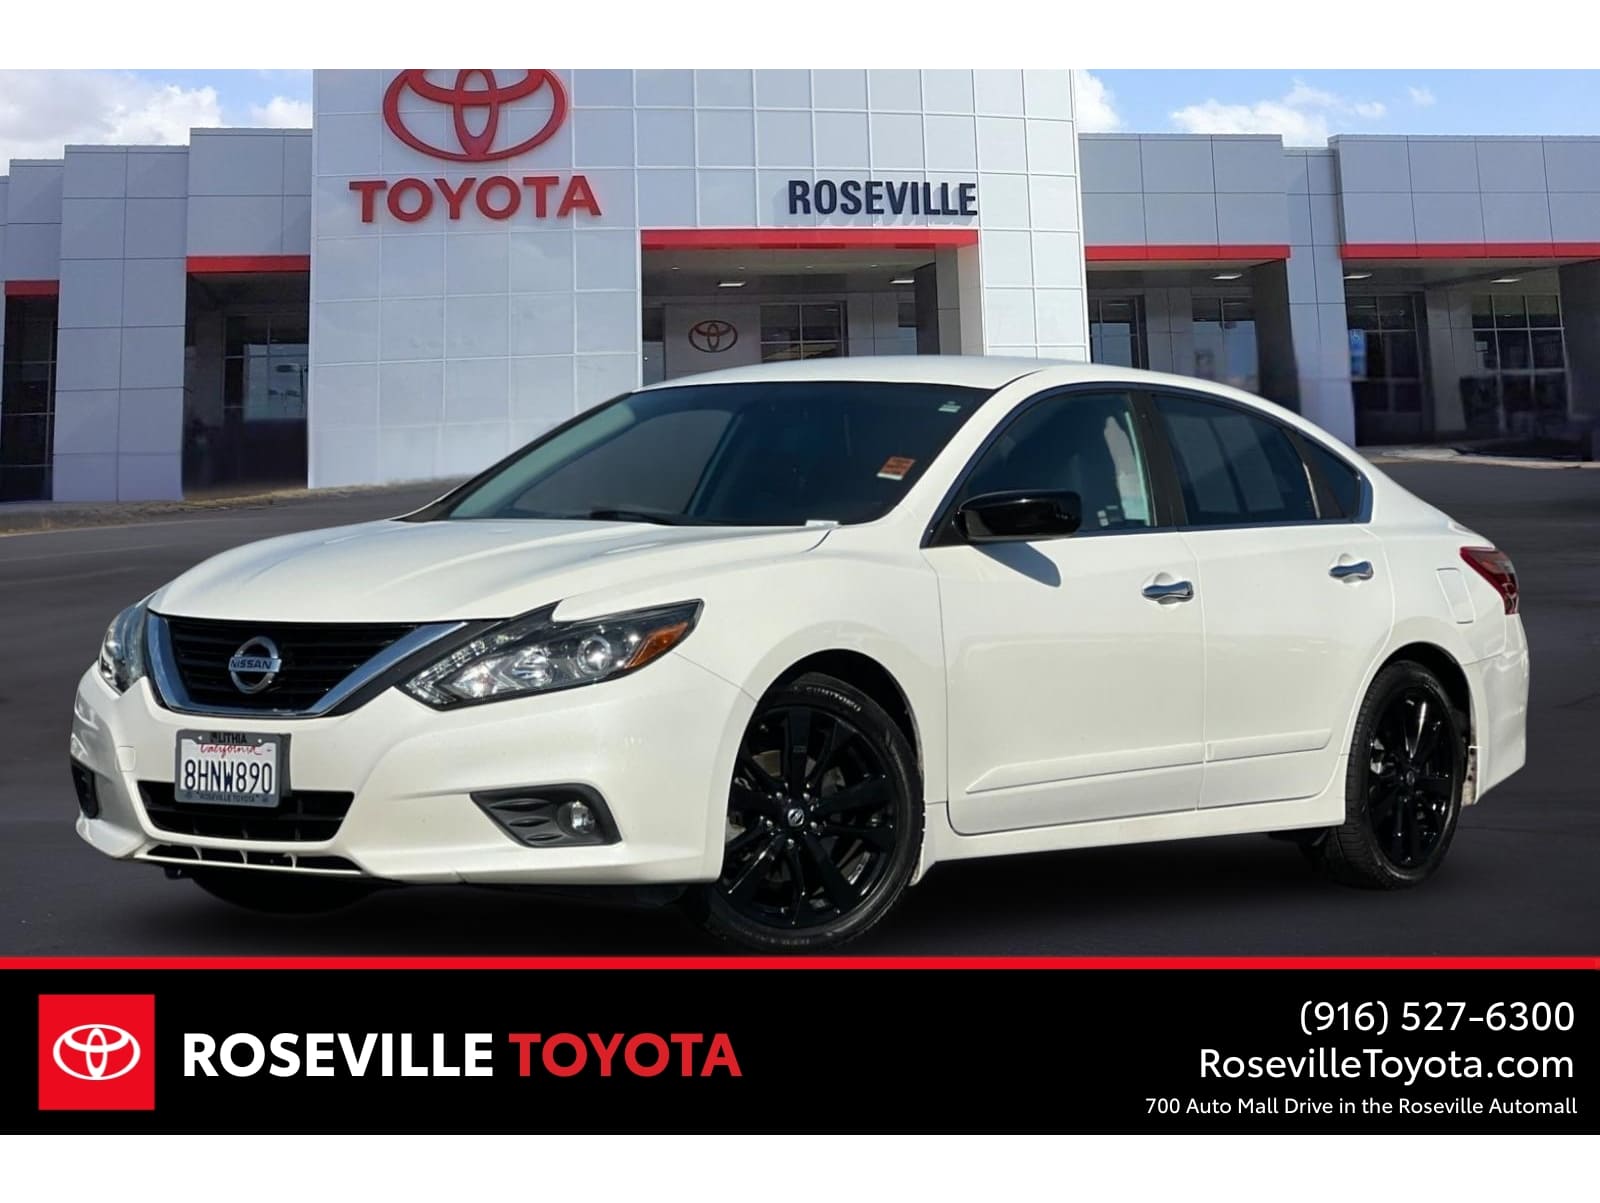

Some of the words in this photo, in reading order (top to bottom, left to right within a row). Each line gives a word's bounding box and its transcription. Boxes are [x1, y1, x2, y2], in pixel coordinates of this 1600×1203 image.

[349, 175, 602, 222] TOYOTA
[788, 180, 978, 217] ROSEVILLE
[230, 659, 273, 670] NISSAN
[184, 759, 273, 795] 8HNW890
